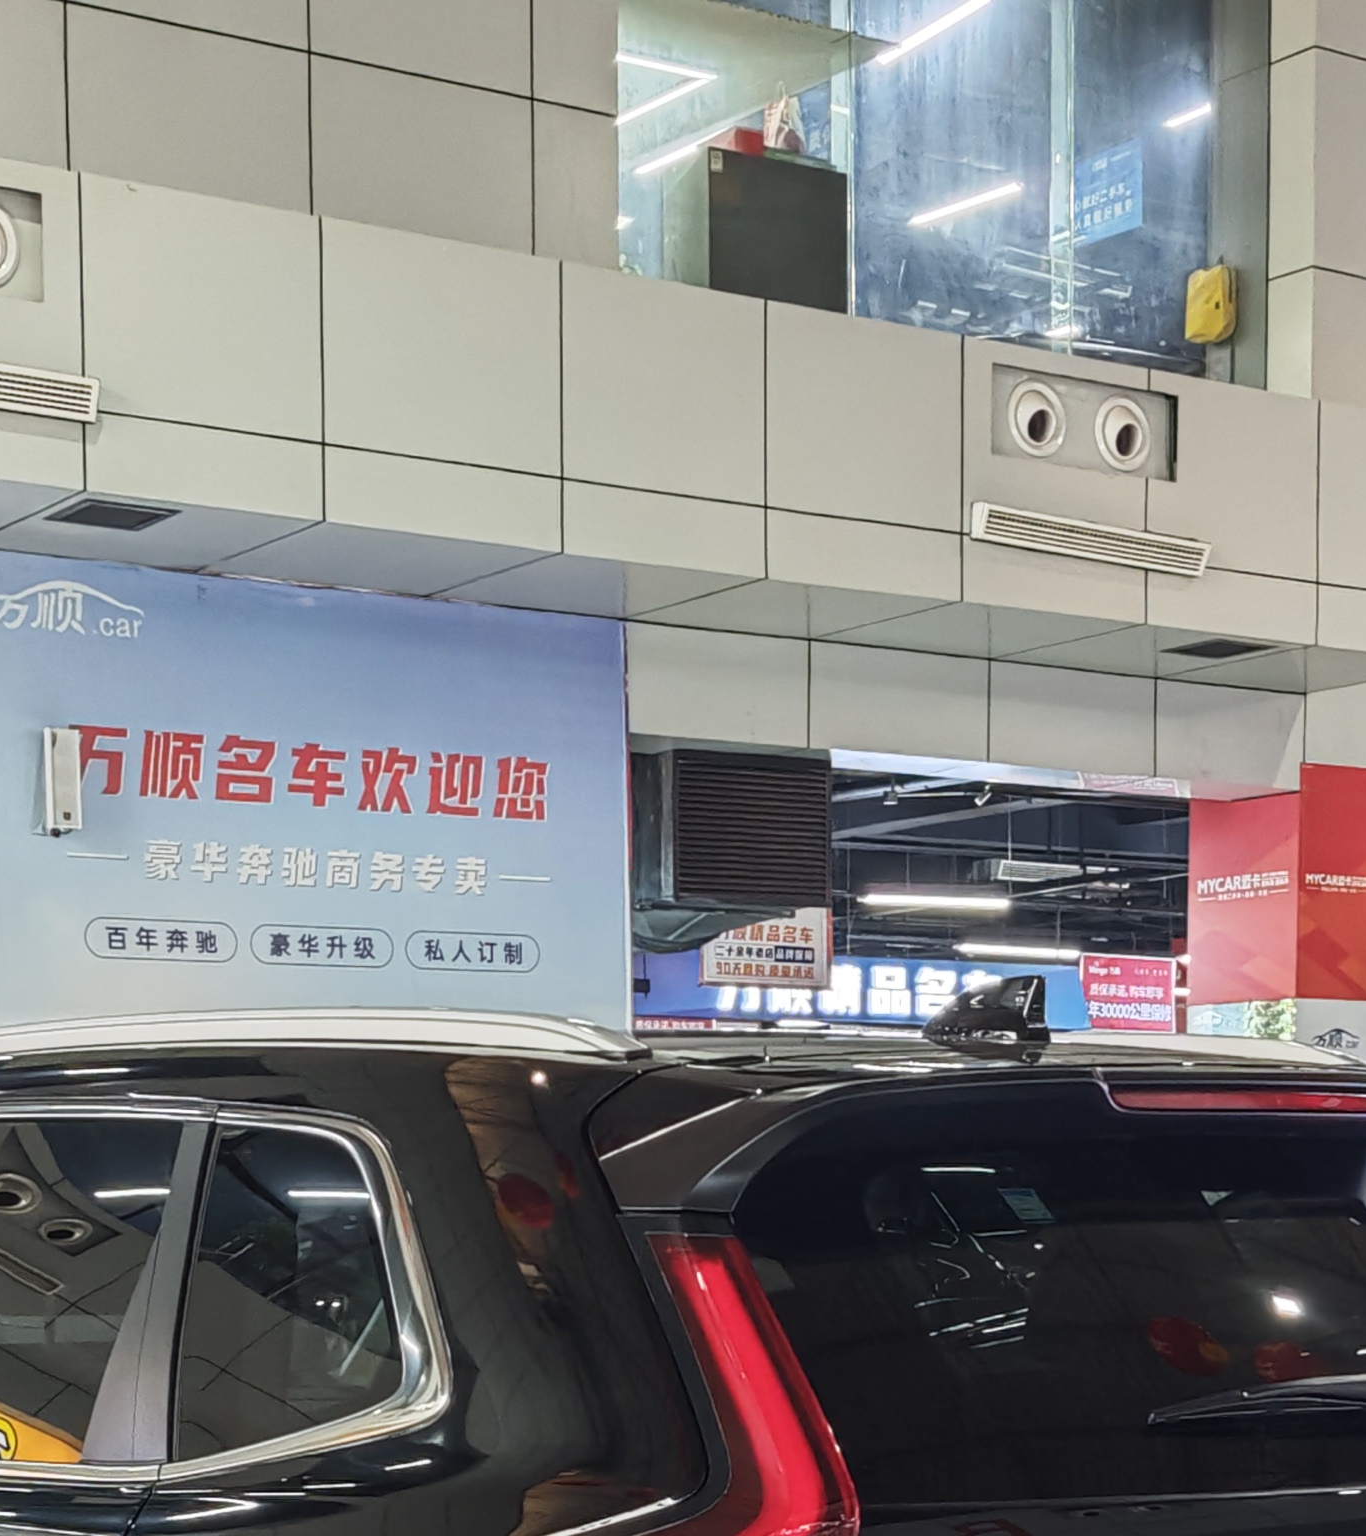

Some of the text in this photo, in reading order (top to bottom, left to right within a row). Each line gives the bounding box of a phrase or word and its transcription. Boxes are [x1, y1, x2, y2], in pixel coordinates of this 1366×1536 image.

[70, 724, 549, 822] 万顺名车欢迎您
[143, 838, 490, 896] 豪华奔驰商务专卖
[105, 924, 525, 966] 百年奔驰 豪华升级 私人订制
[1085, 1001, 1172, 1022] 年30000公里保修
